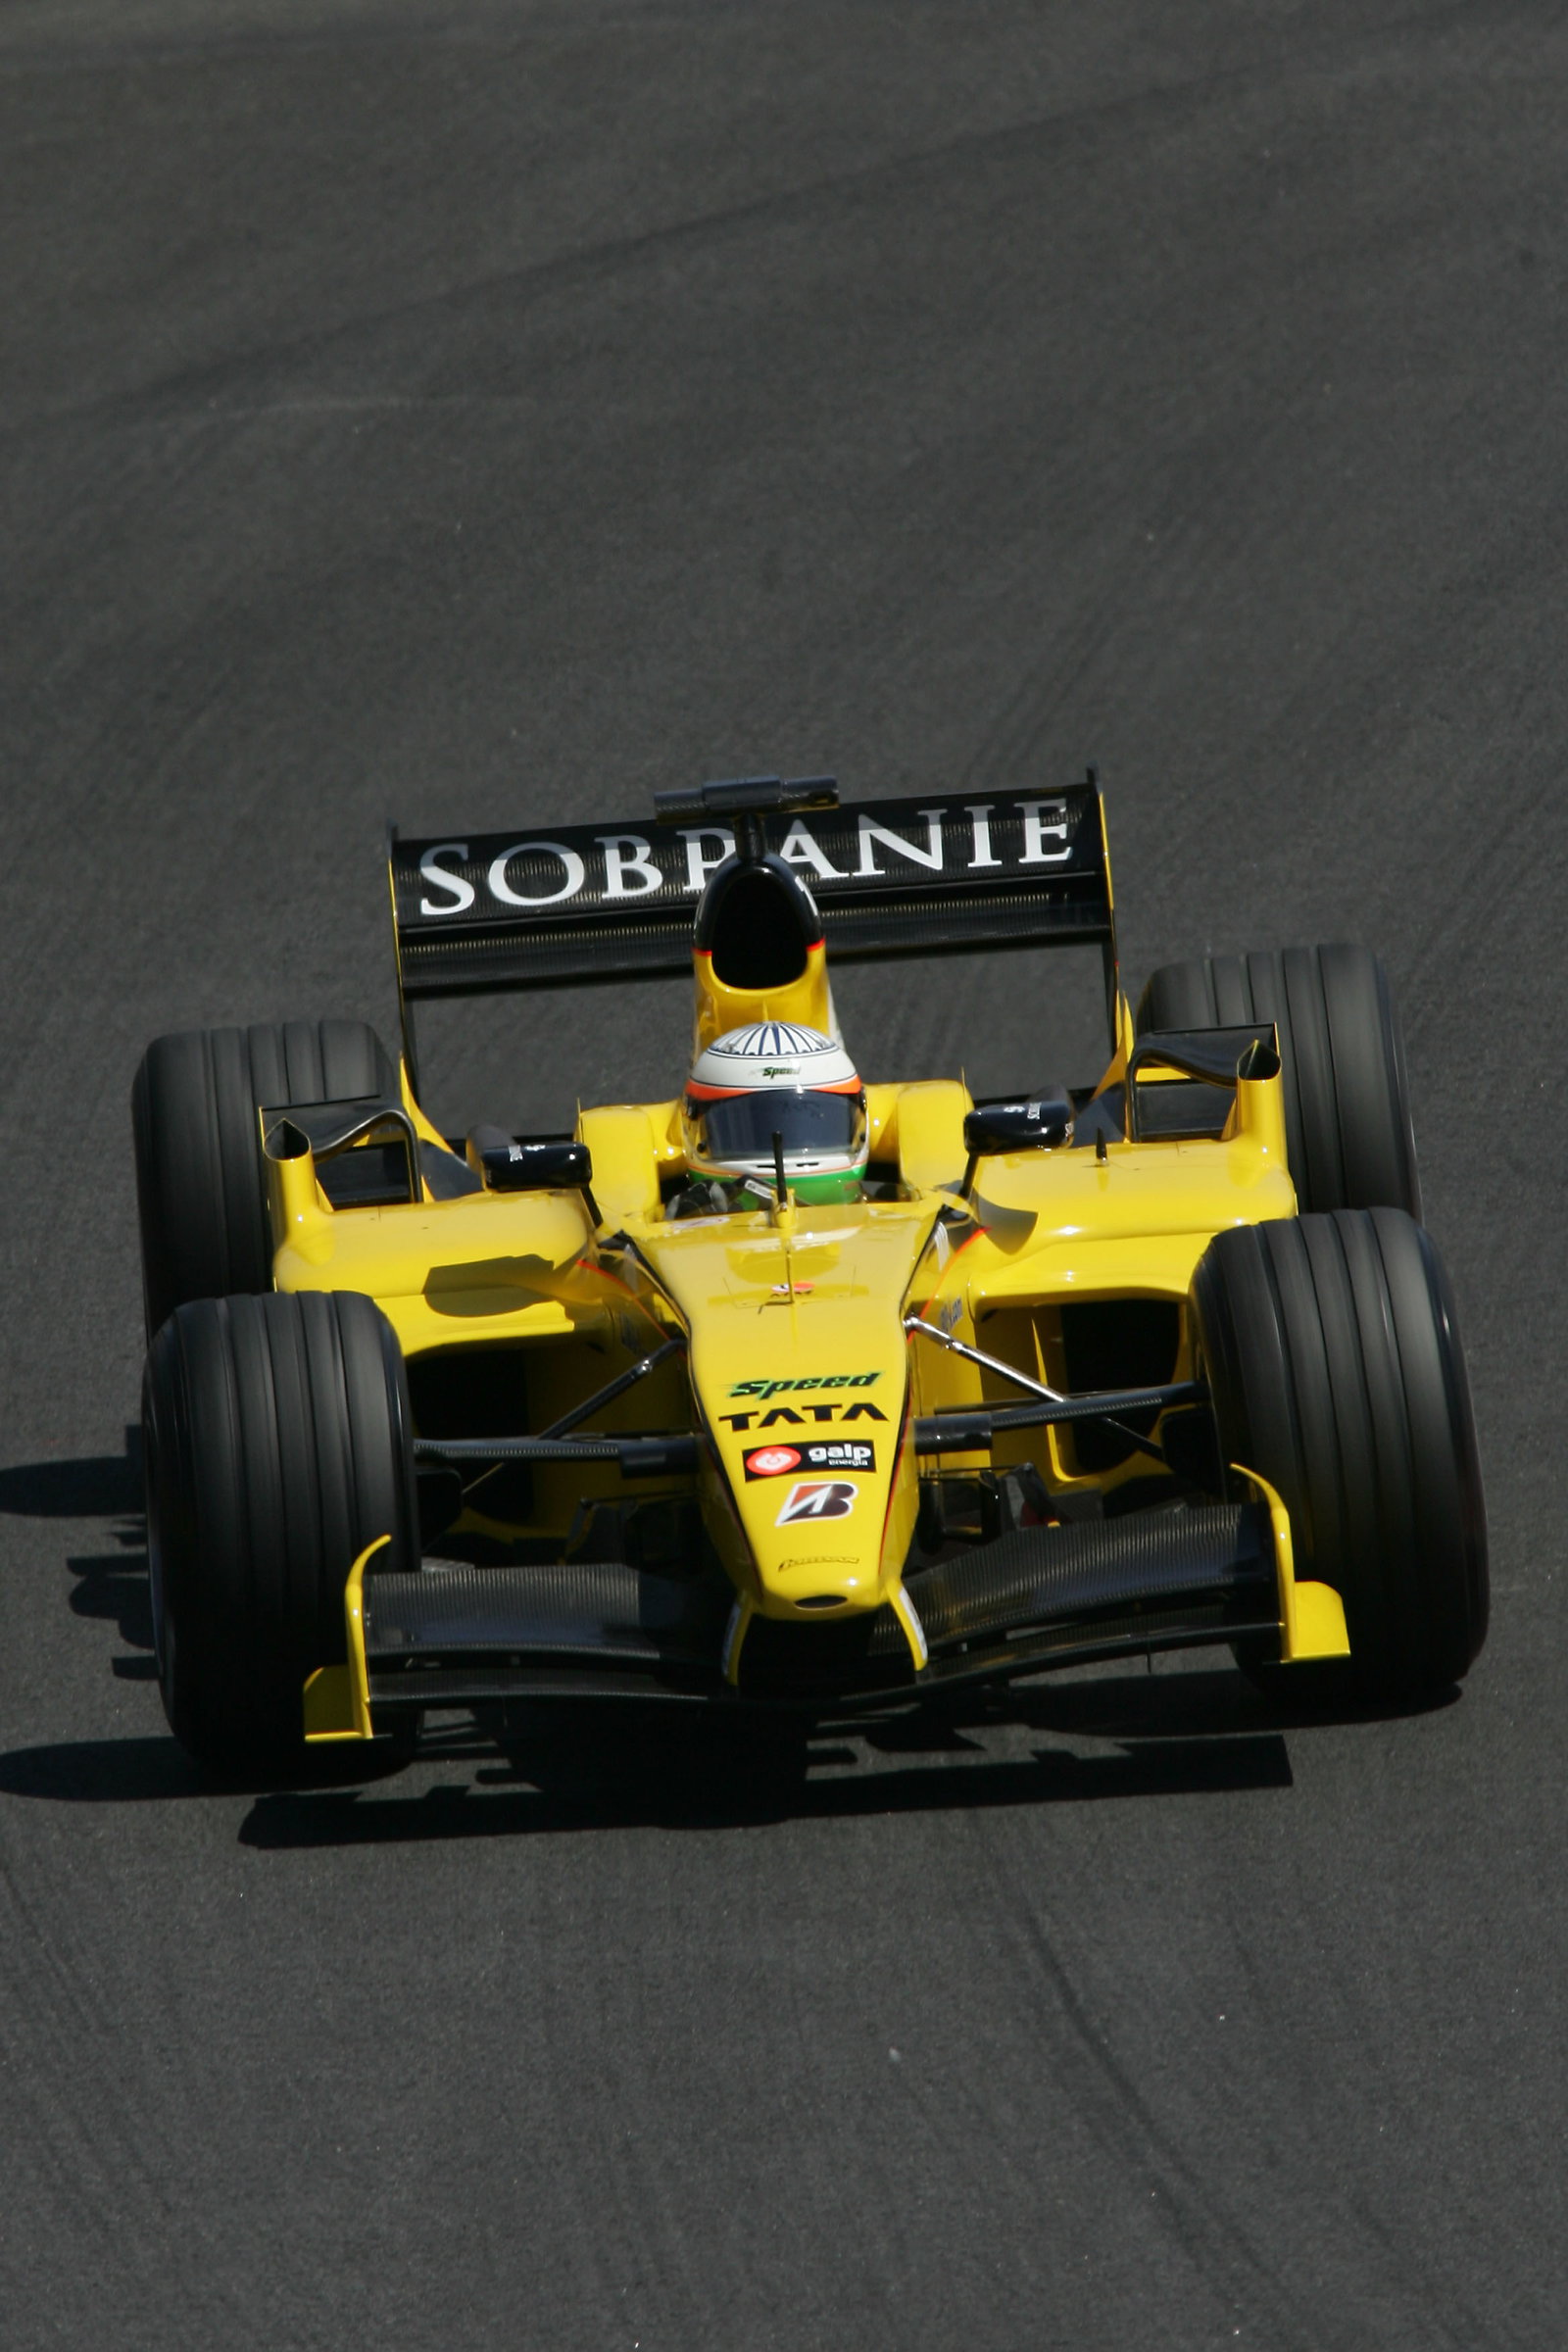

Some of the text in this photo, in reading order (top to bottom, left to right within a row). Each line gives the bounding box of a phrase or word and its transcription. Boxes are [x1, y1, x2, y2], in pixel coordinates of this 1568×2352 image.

[727, 1371, 883, 1400] Speed
[718, 1402, 889, 1432] TATA
[808, 1444, 871, 1462] galp
